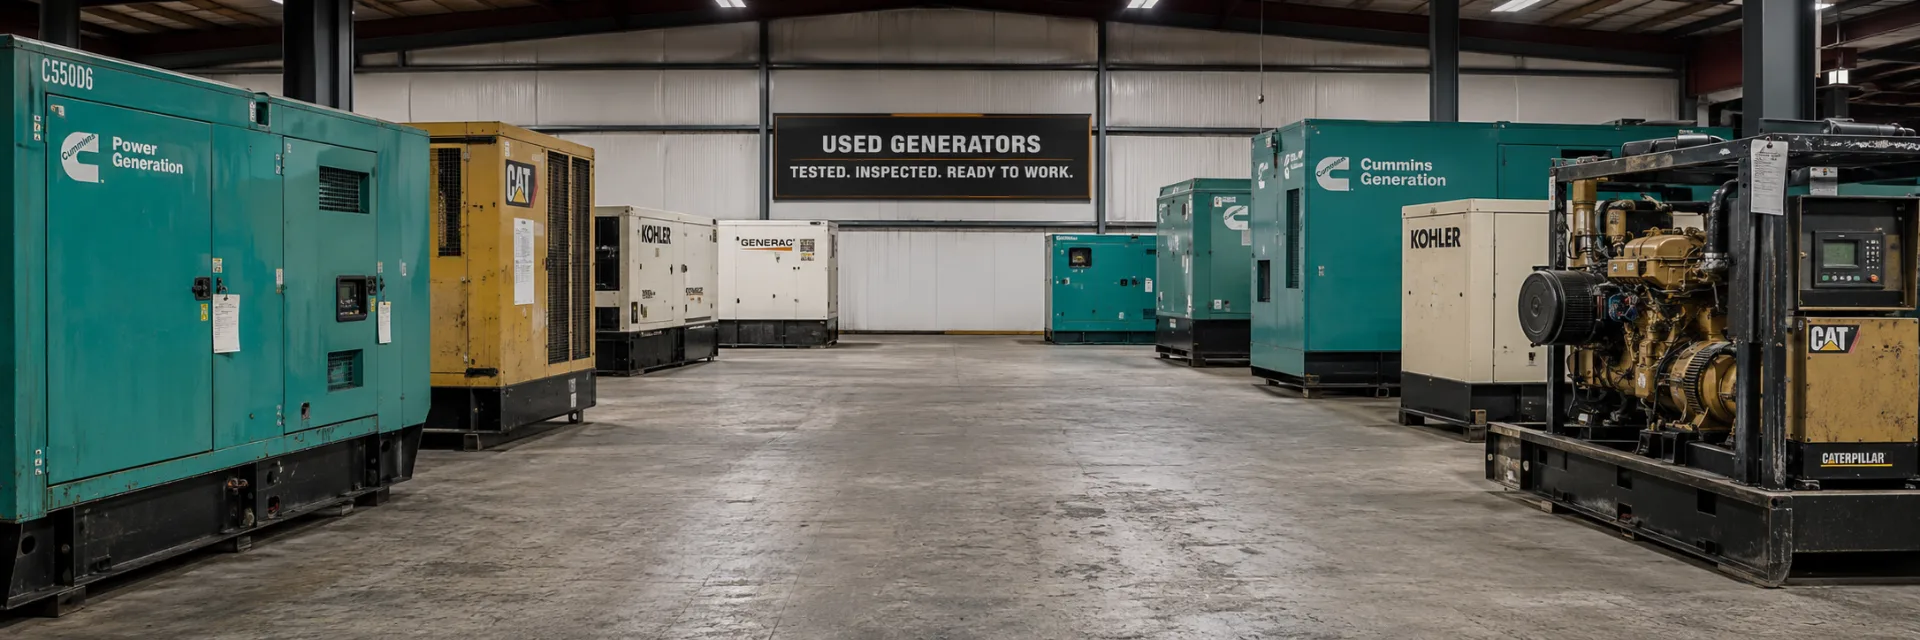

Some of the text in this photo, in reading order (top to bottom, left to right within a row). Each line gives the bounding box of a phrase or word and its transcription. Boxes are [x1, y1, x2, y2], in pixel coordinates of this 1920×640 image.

[42, 58, 93, 90] C550D6
[112, 136, 157, 155] Power
[822, 135, 1042, 153] USED GENERATORS
[112, 152, 184, 174] Generation
[790, 166, 1074, 179] TESTED. INSPECTED. READY TO WORK.
[1360, 157, 1433, 171] Cummins
[506, 164, 531, 203] CAT
[1360, 172, 1447, 187] Generation
[641, 225, 671, 244] KOHLER
[740, 238, 793, 247] GENERAC
[1410, 226, 1461, 249] KOHLER
[1810, 325, 1849, 351] CAT
[1822, 452, 1885, 464] CATERPILLAR
